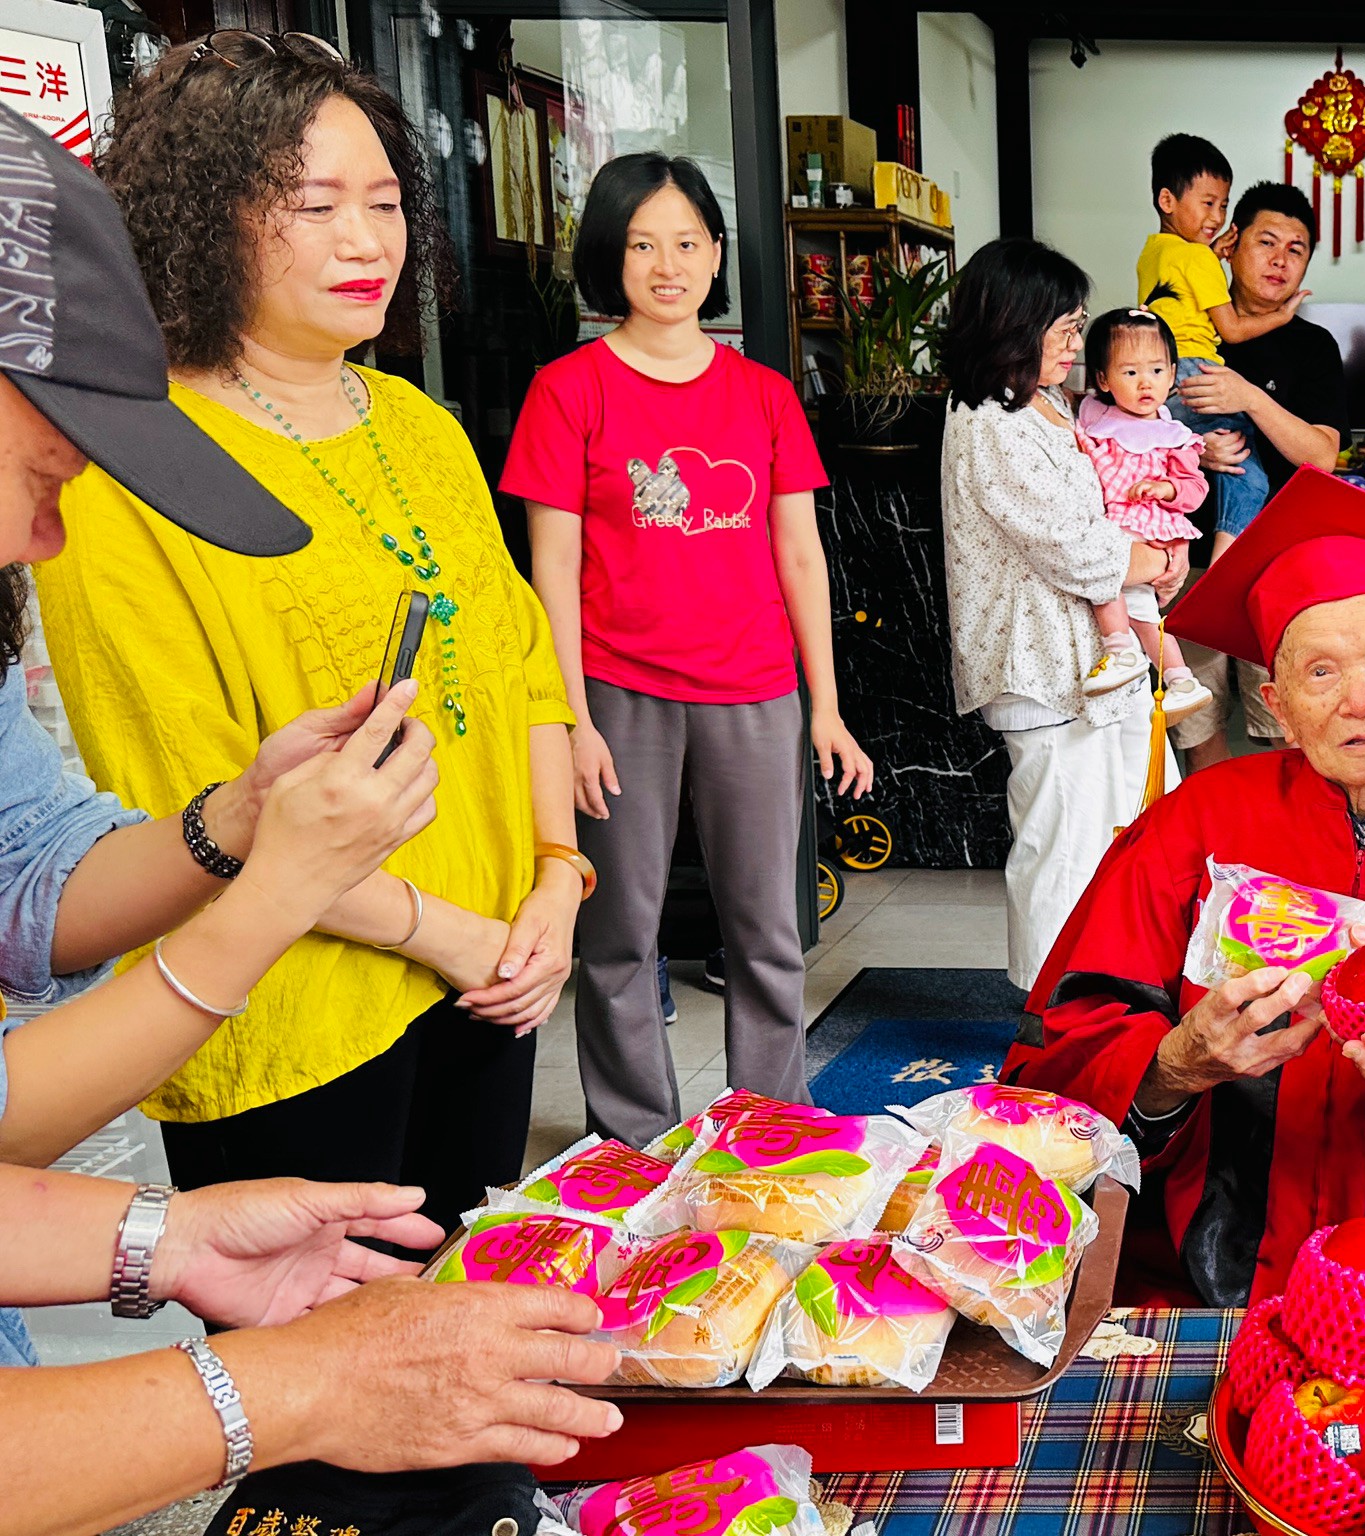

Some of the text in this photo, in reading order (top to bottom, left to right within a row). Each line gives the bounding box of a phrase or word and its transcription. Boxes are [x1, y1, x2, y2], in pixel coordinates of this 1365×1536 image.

[0, 56, 69, 102] 三洋
[632, 504, 752, 534] Greedy Rabbit
